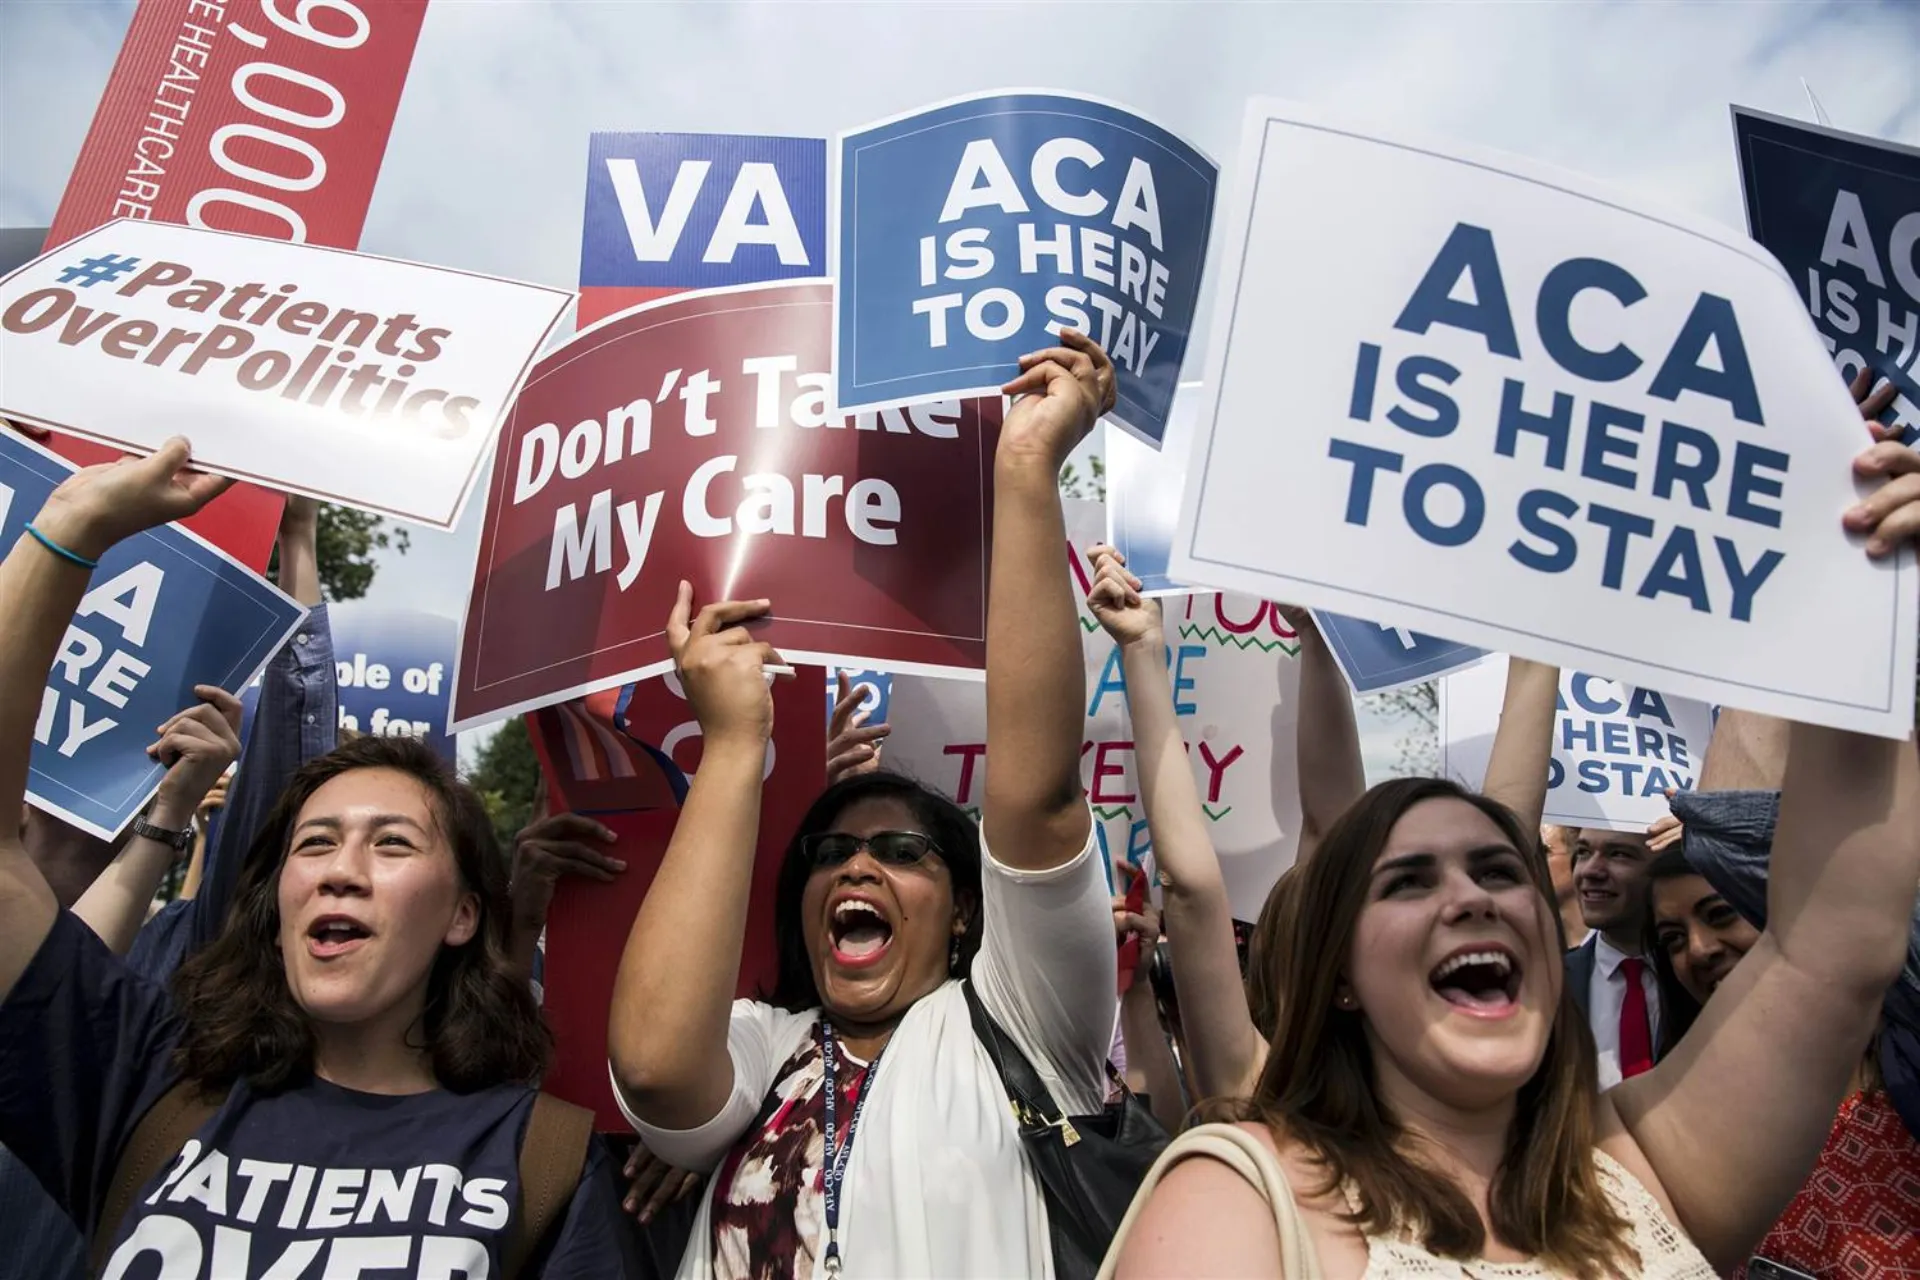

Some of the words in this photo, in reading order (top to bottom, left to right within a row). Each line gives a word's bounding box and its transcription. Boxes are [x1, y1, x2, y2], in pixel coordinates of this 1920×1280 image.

[111, 22, 217, 220] HEALTHCARE
[605, 158, 811, 267] VA
[937, 137, 1164, 252] ACA
[1819, 188, 1920, 303] AC
[56, 252, 453, 363] #Patients
[919, 227, 996, 287] IS
[1018, 222, 1171, 320] HERE
[1393, 221, 1766, 428] ACA
[1807, 267, 1861, 335] IS
[1, 287, 481, 440] OverPolitics
[911, 286, 1026, 349] TO
[1043, 285, 1160, 378] STAY
[513, 368, 721, 506] Don't
[1347, 341, 1464, 440] IS
[1493, 377, 1791, 530] HERE
[544, 489, 665, 592] My
[682, 454, 901, 546] Care
[1327, 437, 1487, 548] TO
[1506, 487, 1787, 624] STAY
[370, 707, 432, 741] for
[402, 662, 444, 695] of
[1088, 644, 1208, 718] AE
[1557, 671, 1676, 728] CA
[1562, 718, 1690, 769] HERE
[1576, 759, 1694, 798] STAY
[145, 1139, 510, 1230] PATIENTS
